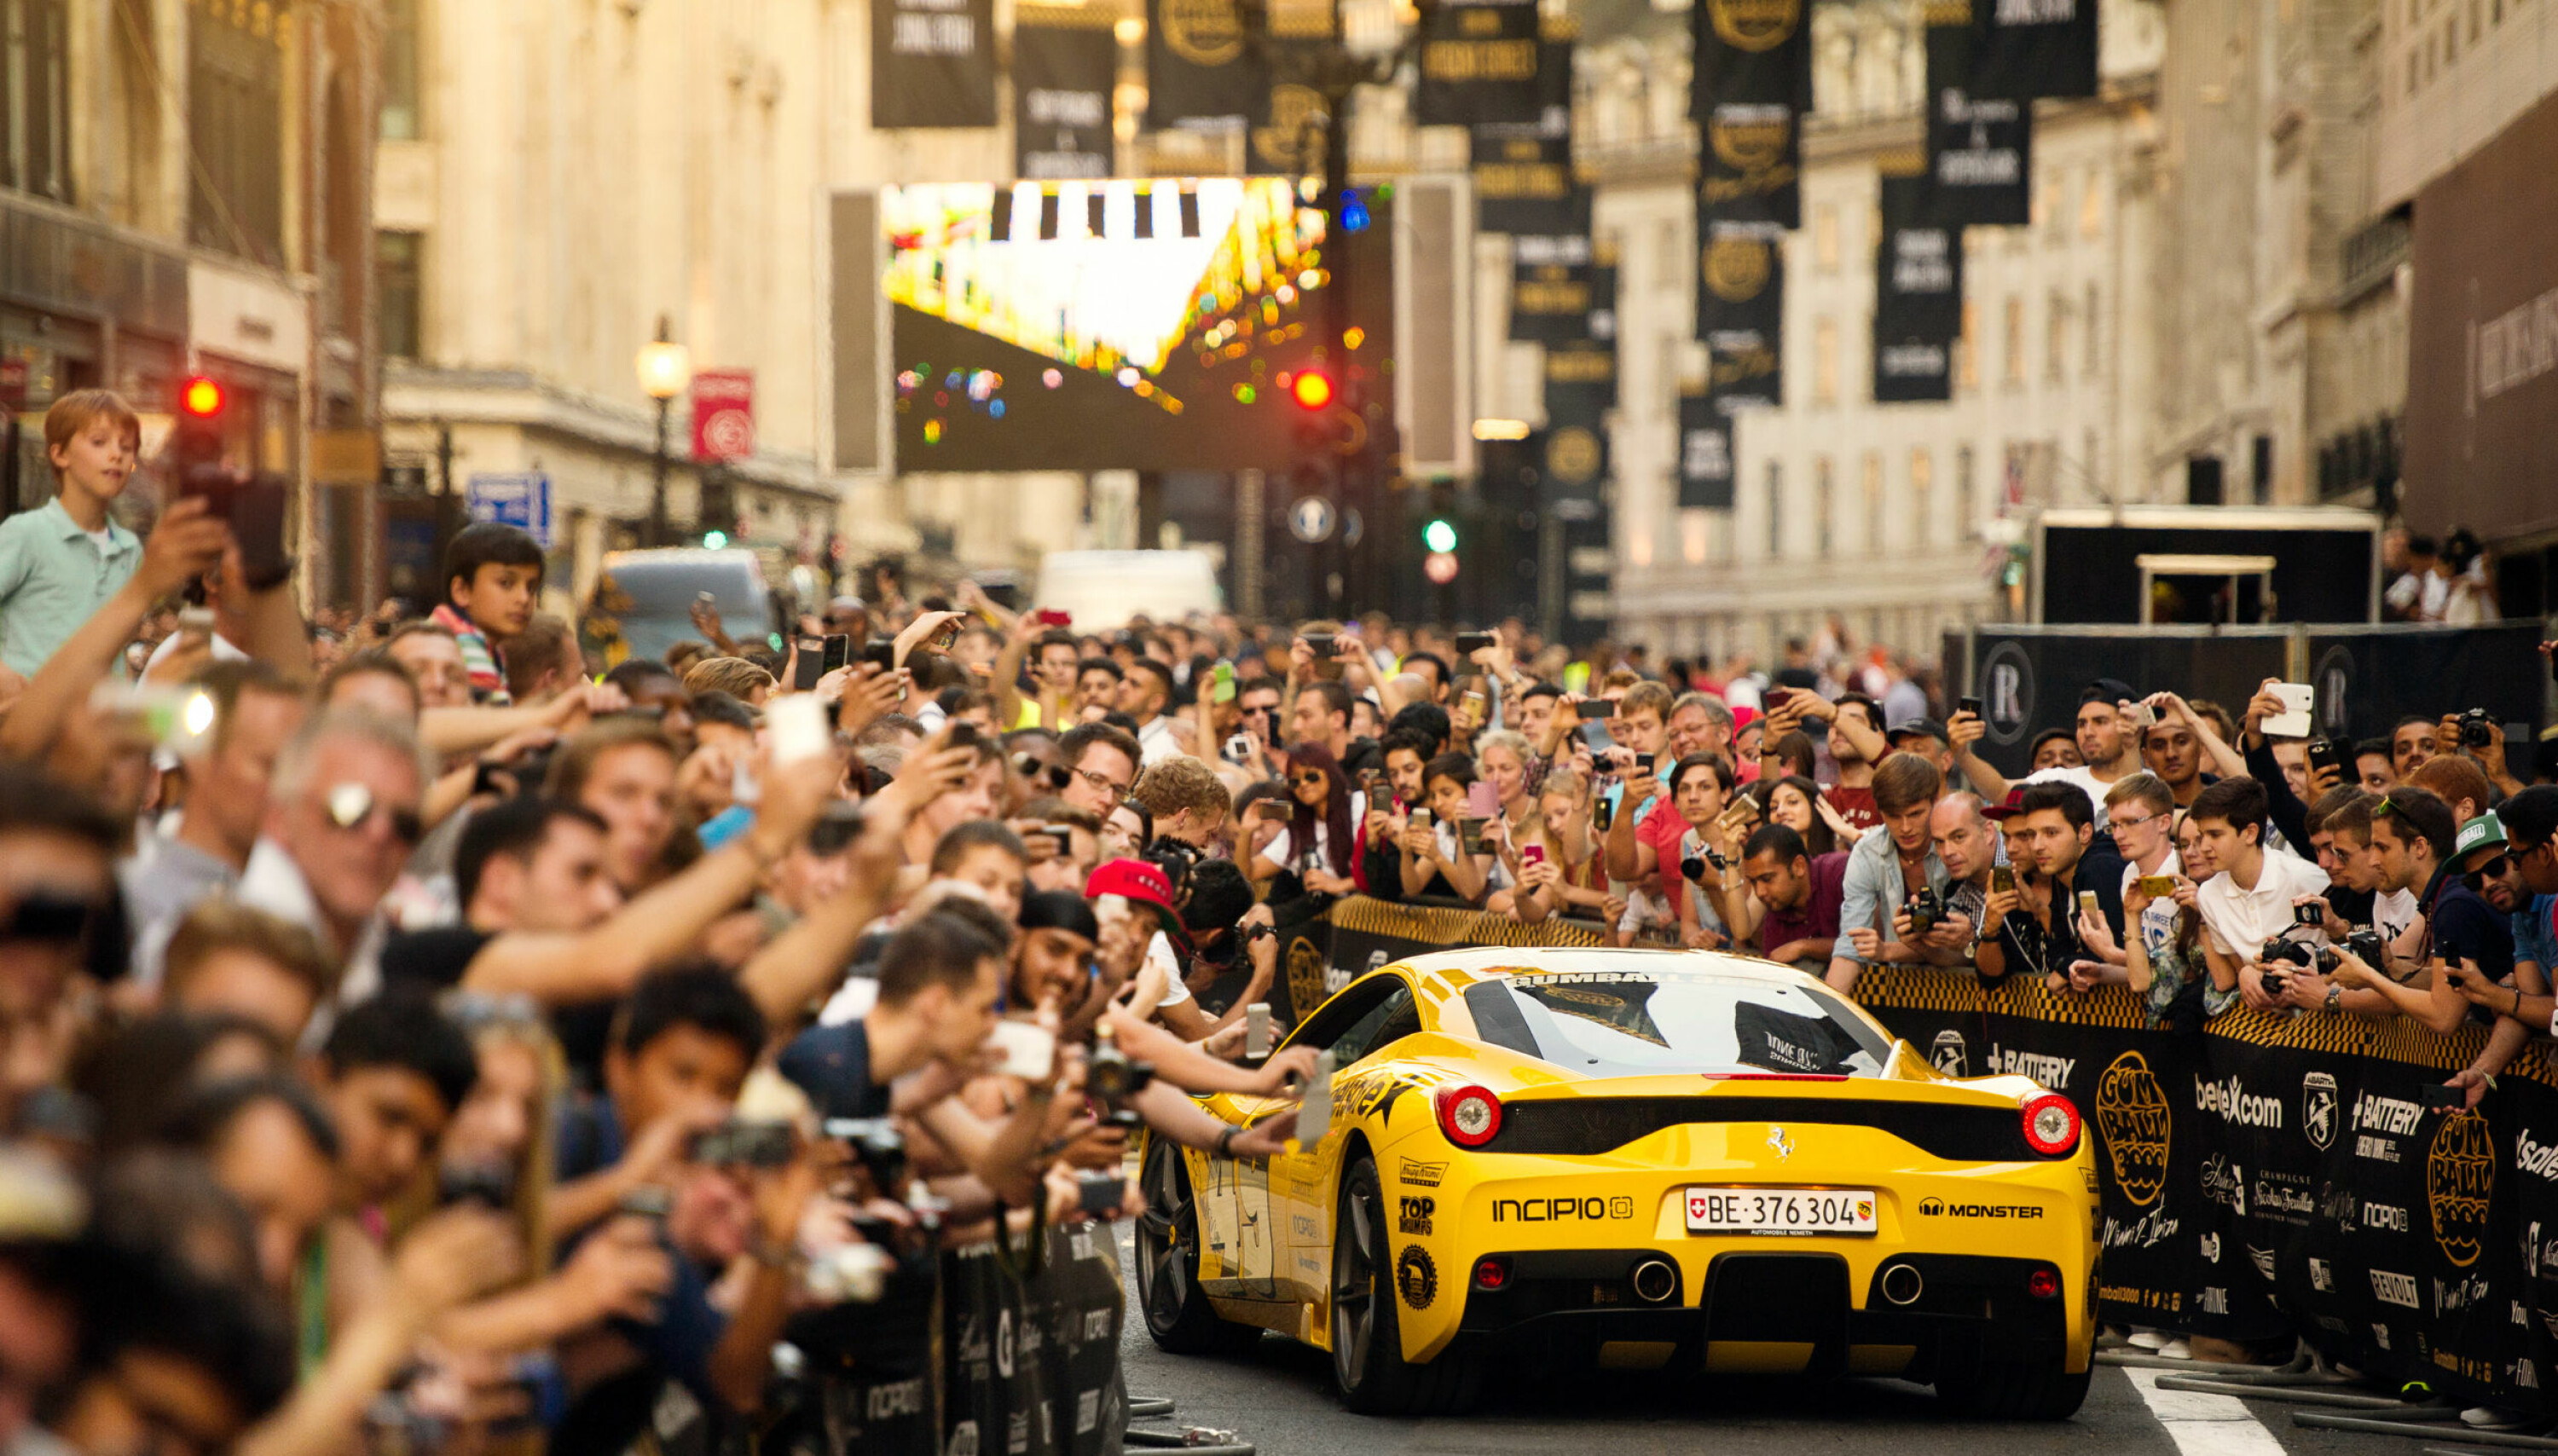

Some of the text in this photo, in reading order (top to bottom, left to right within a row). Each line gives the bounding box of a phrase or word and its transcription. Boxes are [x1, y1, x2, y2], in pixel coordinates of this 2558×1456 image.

[2005, 1049, 2076, 1089] BATTERY
[2362, 1095, 2425, 1136] BATTERY
[1399, 1196, 1436, 1219] TOP
[1492, 1197, 1605, 1222] INCIPIO
[1949, 1205, 2043, 1219] MONSTER
[2370, 1272, 2416, 1304] REVOLT
